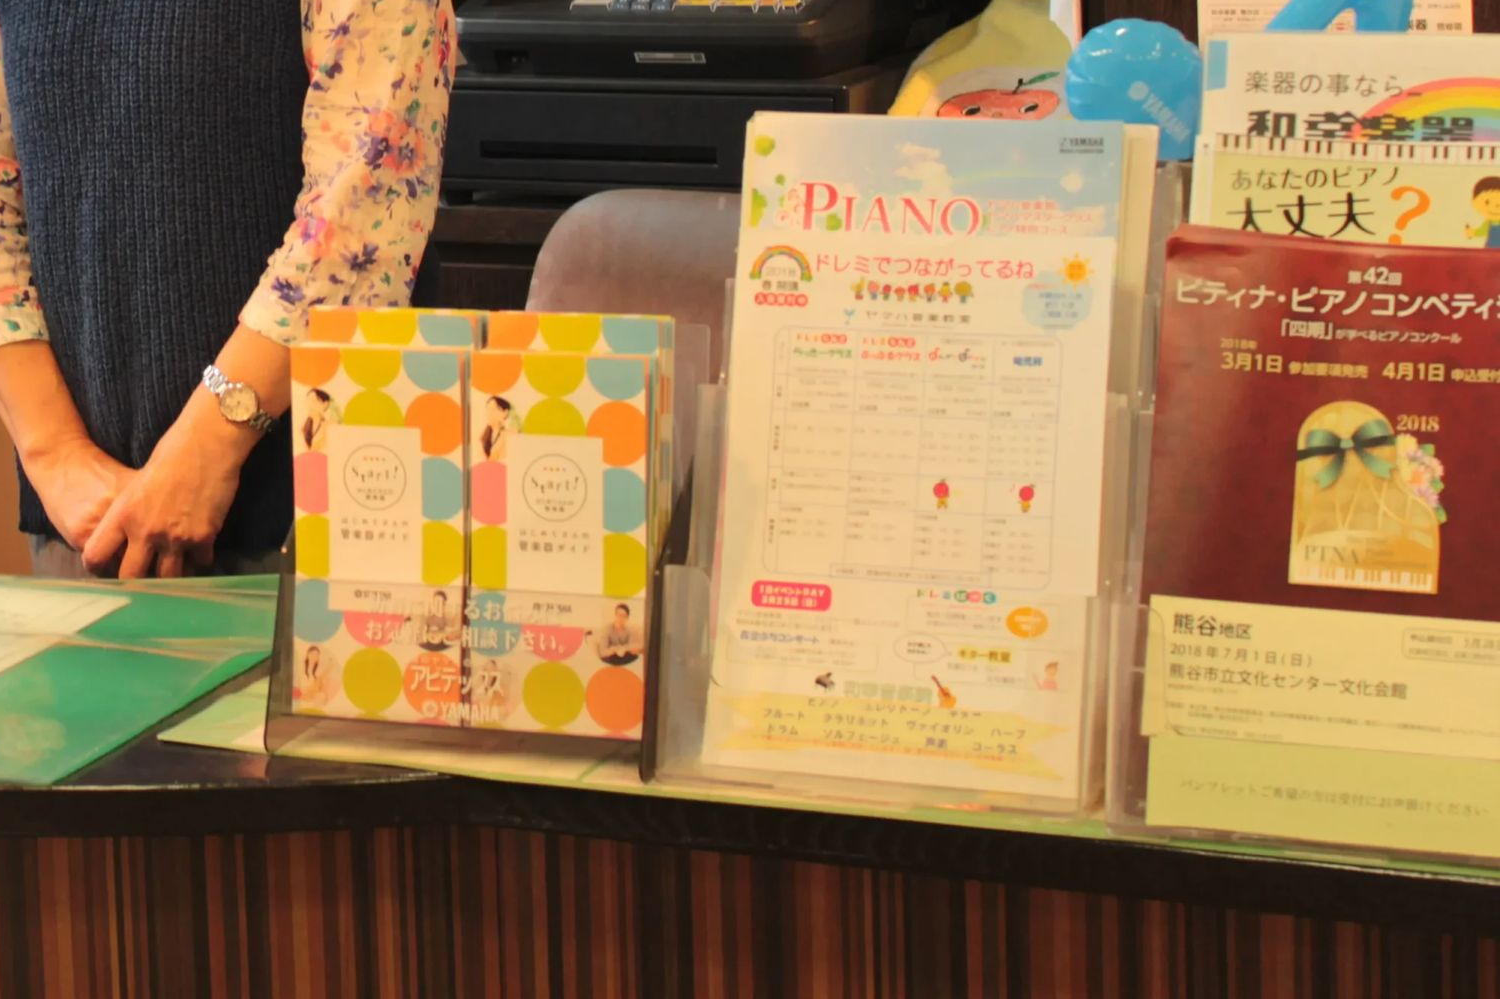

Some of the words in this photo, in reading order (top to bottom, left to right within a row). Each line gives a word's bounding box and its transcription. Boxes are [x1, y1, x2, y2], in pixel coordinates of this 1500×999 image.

[1247, 108, 1475, 143] 和幸楽器
[1231, 166, 1401, 192] あなたのピアノ
[800, 181, 983, 236] PIANO
[816, 253, 1035, 280] ドレミでつながってるね
[1348, 266, 1403, 287] 第42回
[1175, 277, 1500, 320] ピティナ・ピアノコンペティ
[1220, 351, 1284, 374] 3月1日
[1381, 362, 1446, 383] 4月1日
[1396, 413, 1441, 433] 2018
[1172, 612, 1253, 640] 熊谷地区
[410, 664, 504, 695] アビテックス
[1167, 662, 1409, 700] 熊谷市立文化センター文化会館
[439, 702, 501, 724] YAMAHA
